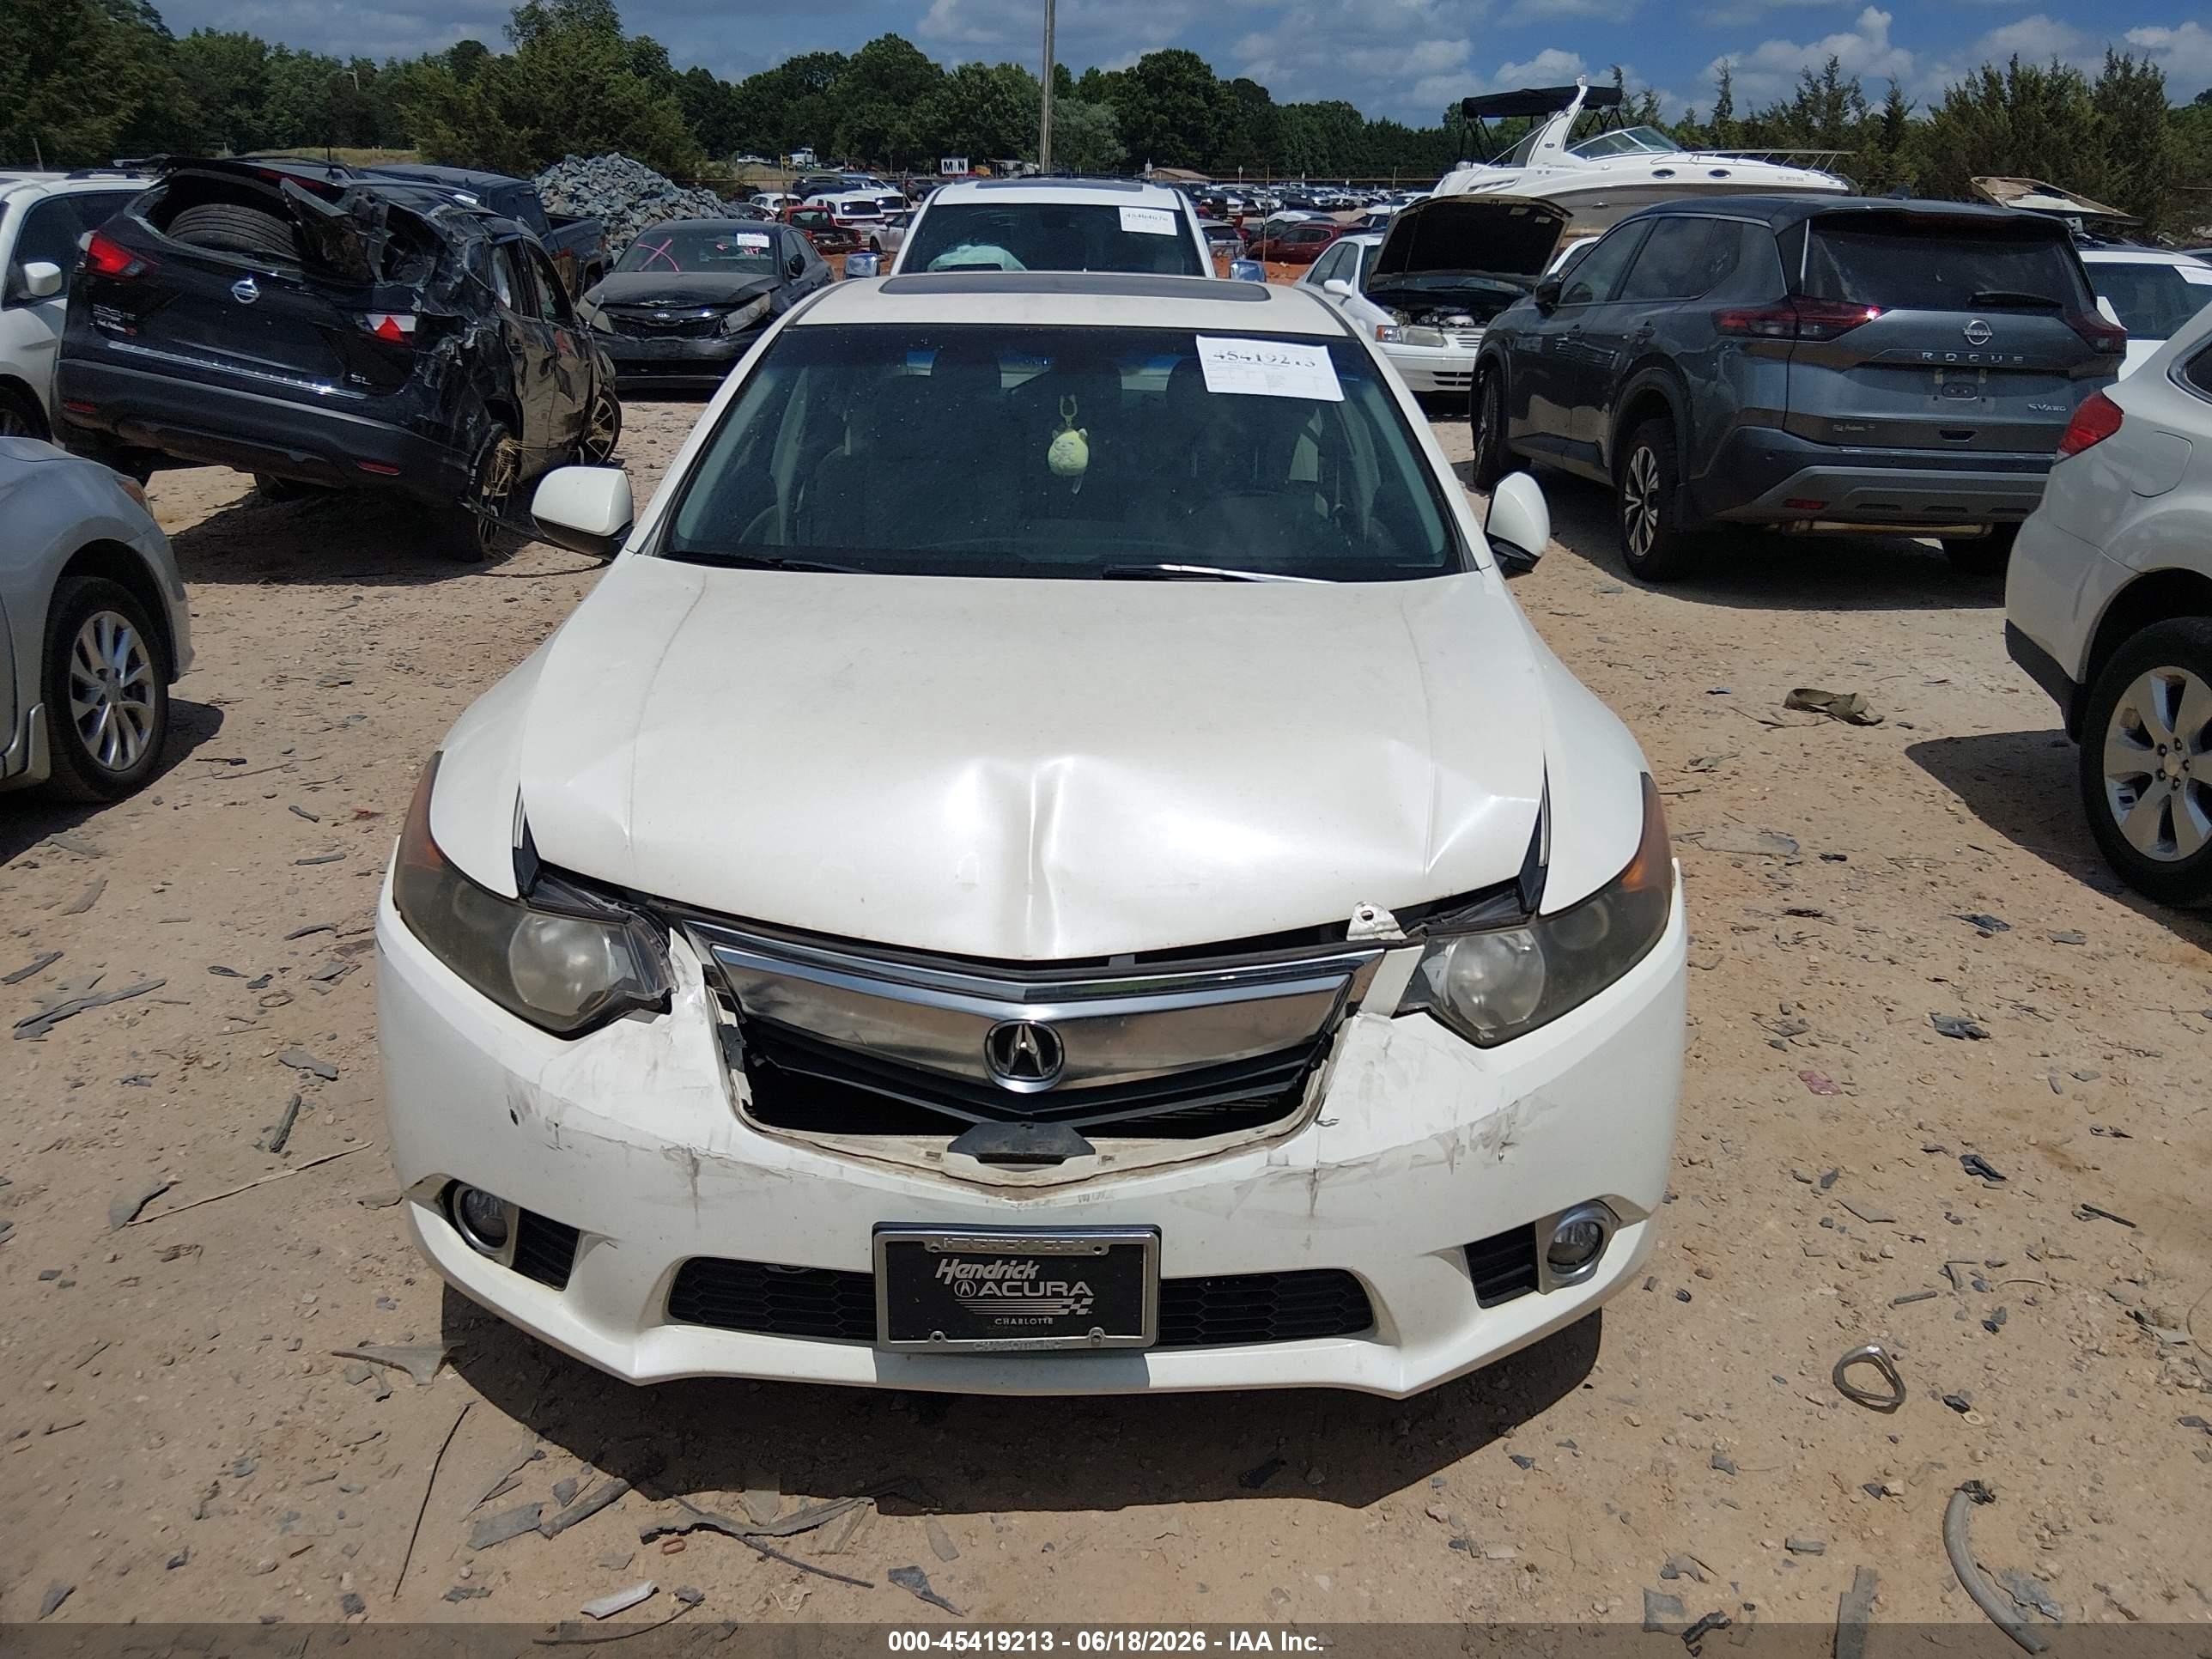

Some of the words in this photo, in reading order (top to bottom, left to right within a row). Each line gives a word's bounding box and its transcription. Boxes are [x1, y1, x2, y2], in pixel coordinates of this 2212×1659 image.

[1963, 329, 1993, 337] NISSAN
[1921, 351, 2024, 365] ROGUE
[349, 373, 373, 386] SL
[934, 1259, 1041, 1285] Hendrick
[977, 1280, 1095, 1297] ACURA
[994, 1316, 1054, 1326] CHARLOTTE
